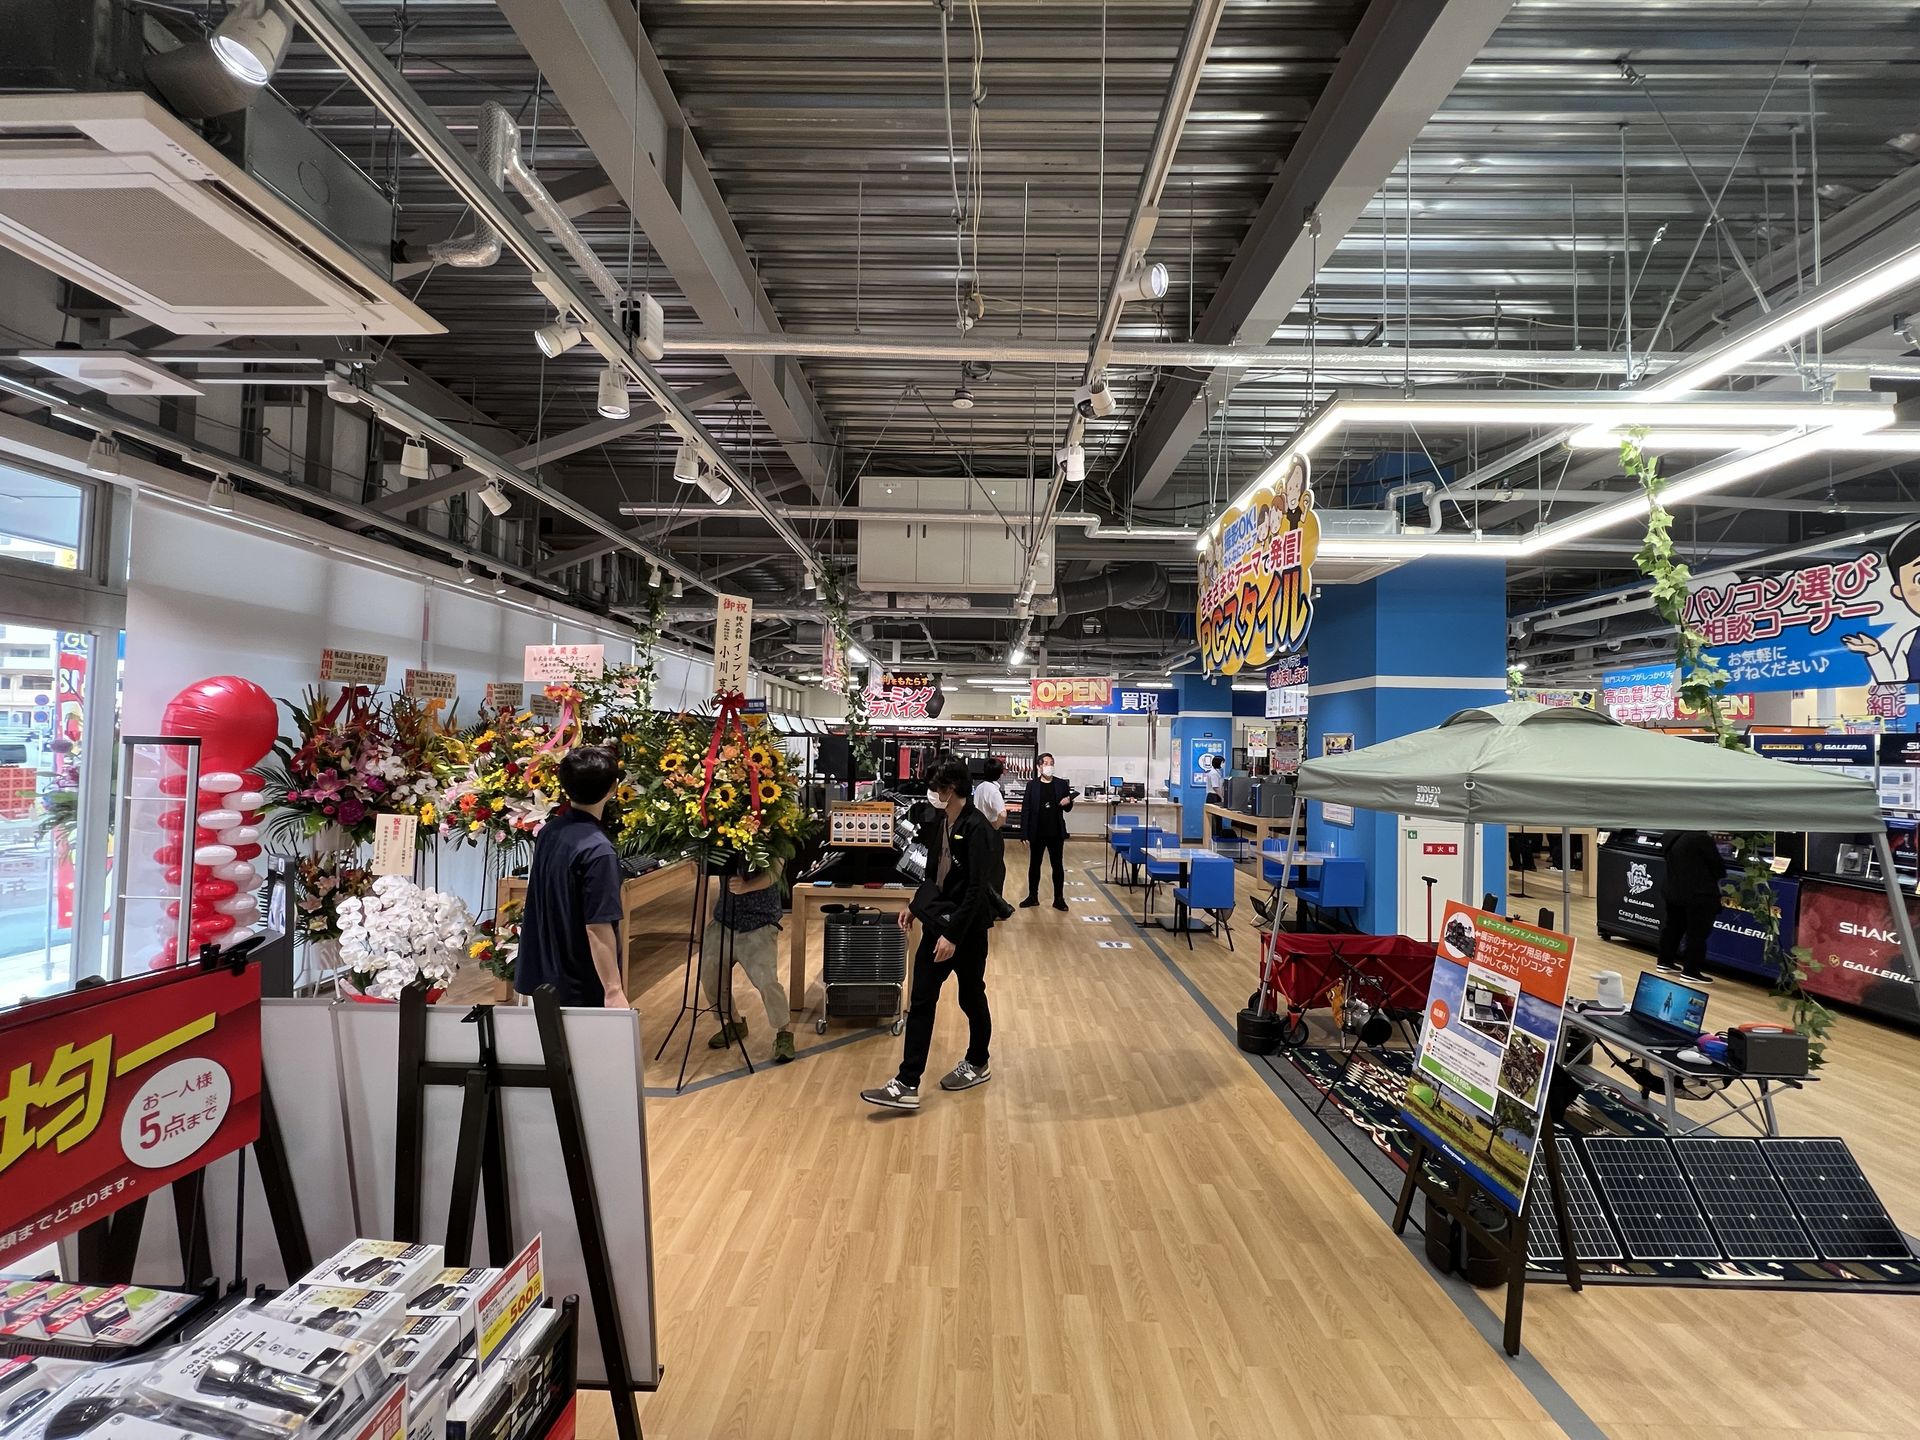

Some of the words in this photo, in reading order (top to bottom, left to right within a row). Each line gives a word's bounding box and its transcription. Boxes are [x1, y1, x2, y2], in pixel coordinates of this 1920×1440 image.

[1682, 552, 1881, 621] パソコン選び
[723, 598, 748, 613] 御祝
[1201, 568, 1309, 681] PCスタイル
[732, 642, 743, 692] インプレス
[1728, 646, 1788, 666] お気軽に
[1037, 681, 1108, 703] OPEN
[1121, 692, 1159, 711] 買取
[869, 702, 929, 718] デバイス
[142, 1070, 214, 1112] お一人様
[139, 1105, 217, 1151] 5点まで
